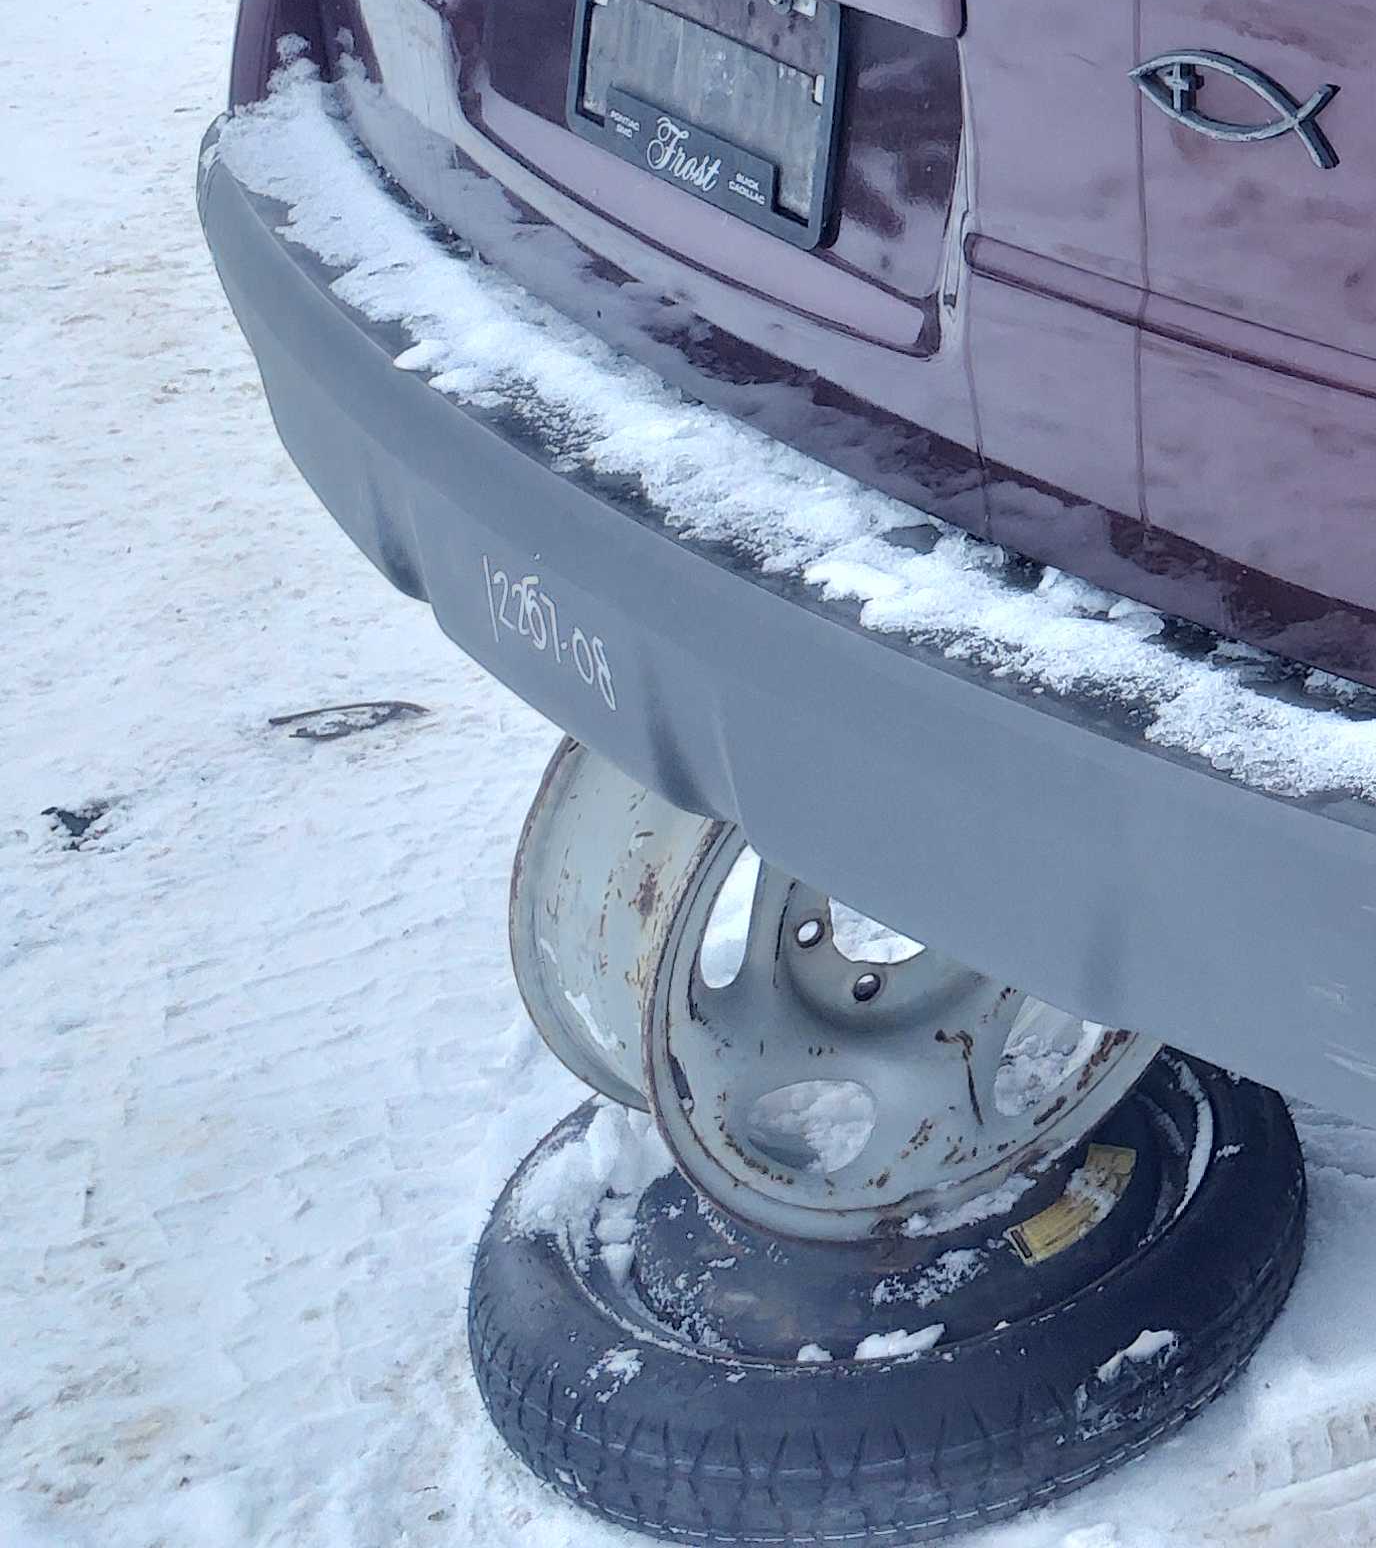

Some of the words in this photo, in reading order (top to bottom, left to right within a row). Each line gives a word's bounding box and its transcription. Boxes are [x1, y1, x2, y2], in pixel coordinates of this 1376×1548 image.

[610, 110, 640, 132] PONTIAC
[647, 116, 722, 192] Frost
[728, 180, 766, 205] CADILLAC
